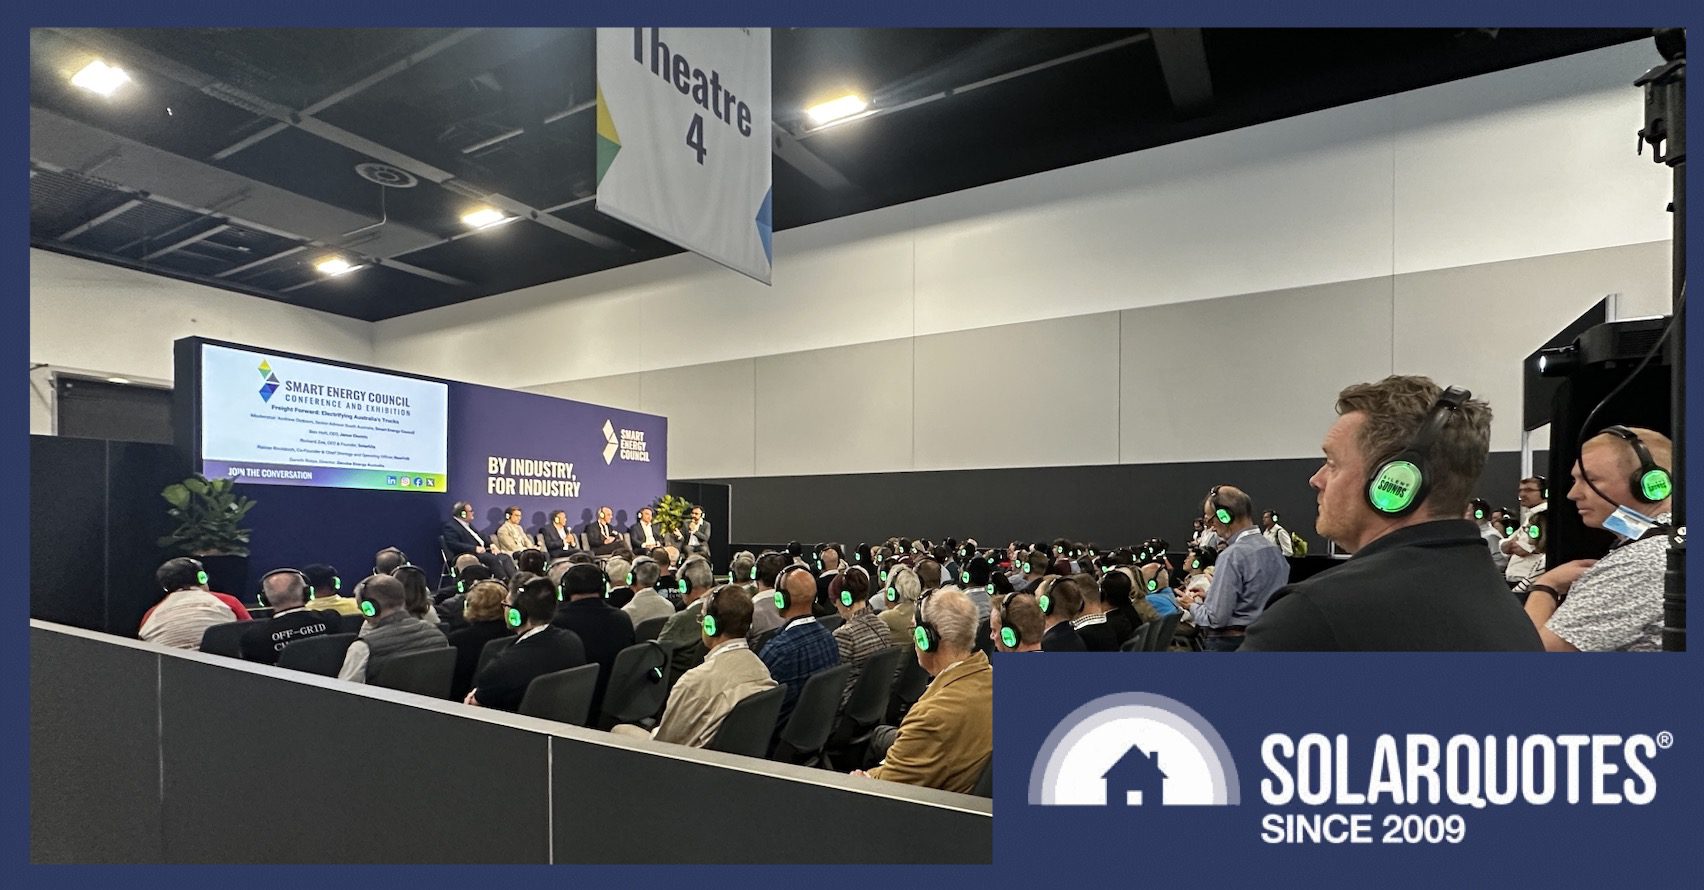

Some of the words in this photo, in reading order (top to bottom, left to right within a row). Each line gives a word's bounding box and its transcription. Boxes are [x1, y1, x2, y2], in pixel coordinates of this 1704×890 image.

[686, 112, 707, 165] 4
[285, 380, 325, 395] SMART
[327, 386, 367, 402] ENERGY
[368, 392, 411, 408] COUNCIL
[271, 404, 293, 412] Freight
[321, 410, 353, 420] Electrifying
[285, 394, 342, 408] CONFERENCE
[345, 402, 362, 411] AND
[366, 404, 411, 416] EXHIBITION
[620, 429, 645, 441] SMART
[620, 439, 647, 451] ENERGY
[620, 449, 650, 462] COUNCIL
[228, 467, 246, 476] JOIN
[246, 468, 260, 477] THE
[261, 469, 313, 480] CONVERSATION
[488, 456, 507, 475] BY
[510, 458, 576, 481] INDUSTRY,
[488, 477, 516, 495] FOR
[519, 478, 580, 498] INDUSTRY
[1378, 480, 1407, 498] SOUNDS
[271, 623, 327, 641] OFF-GRID
